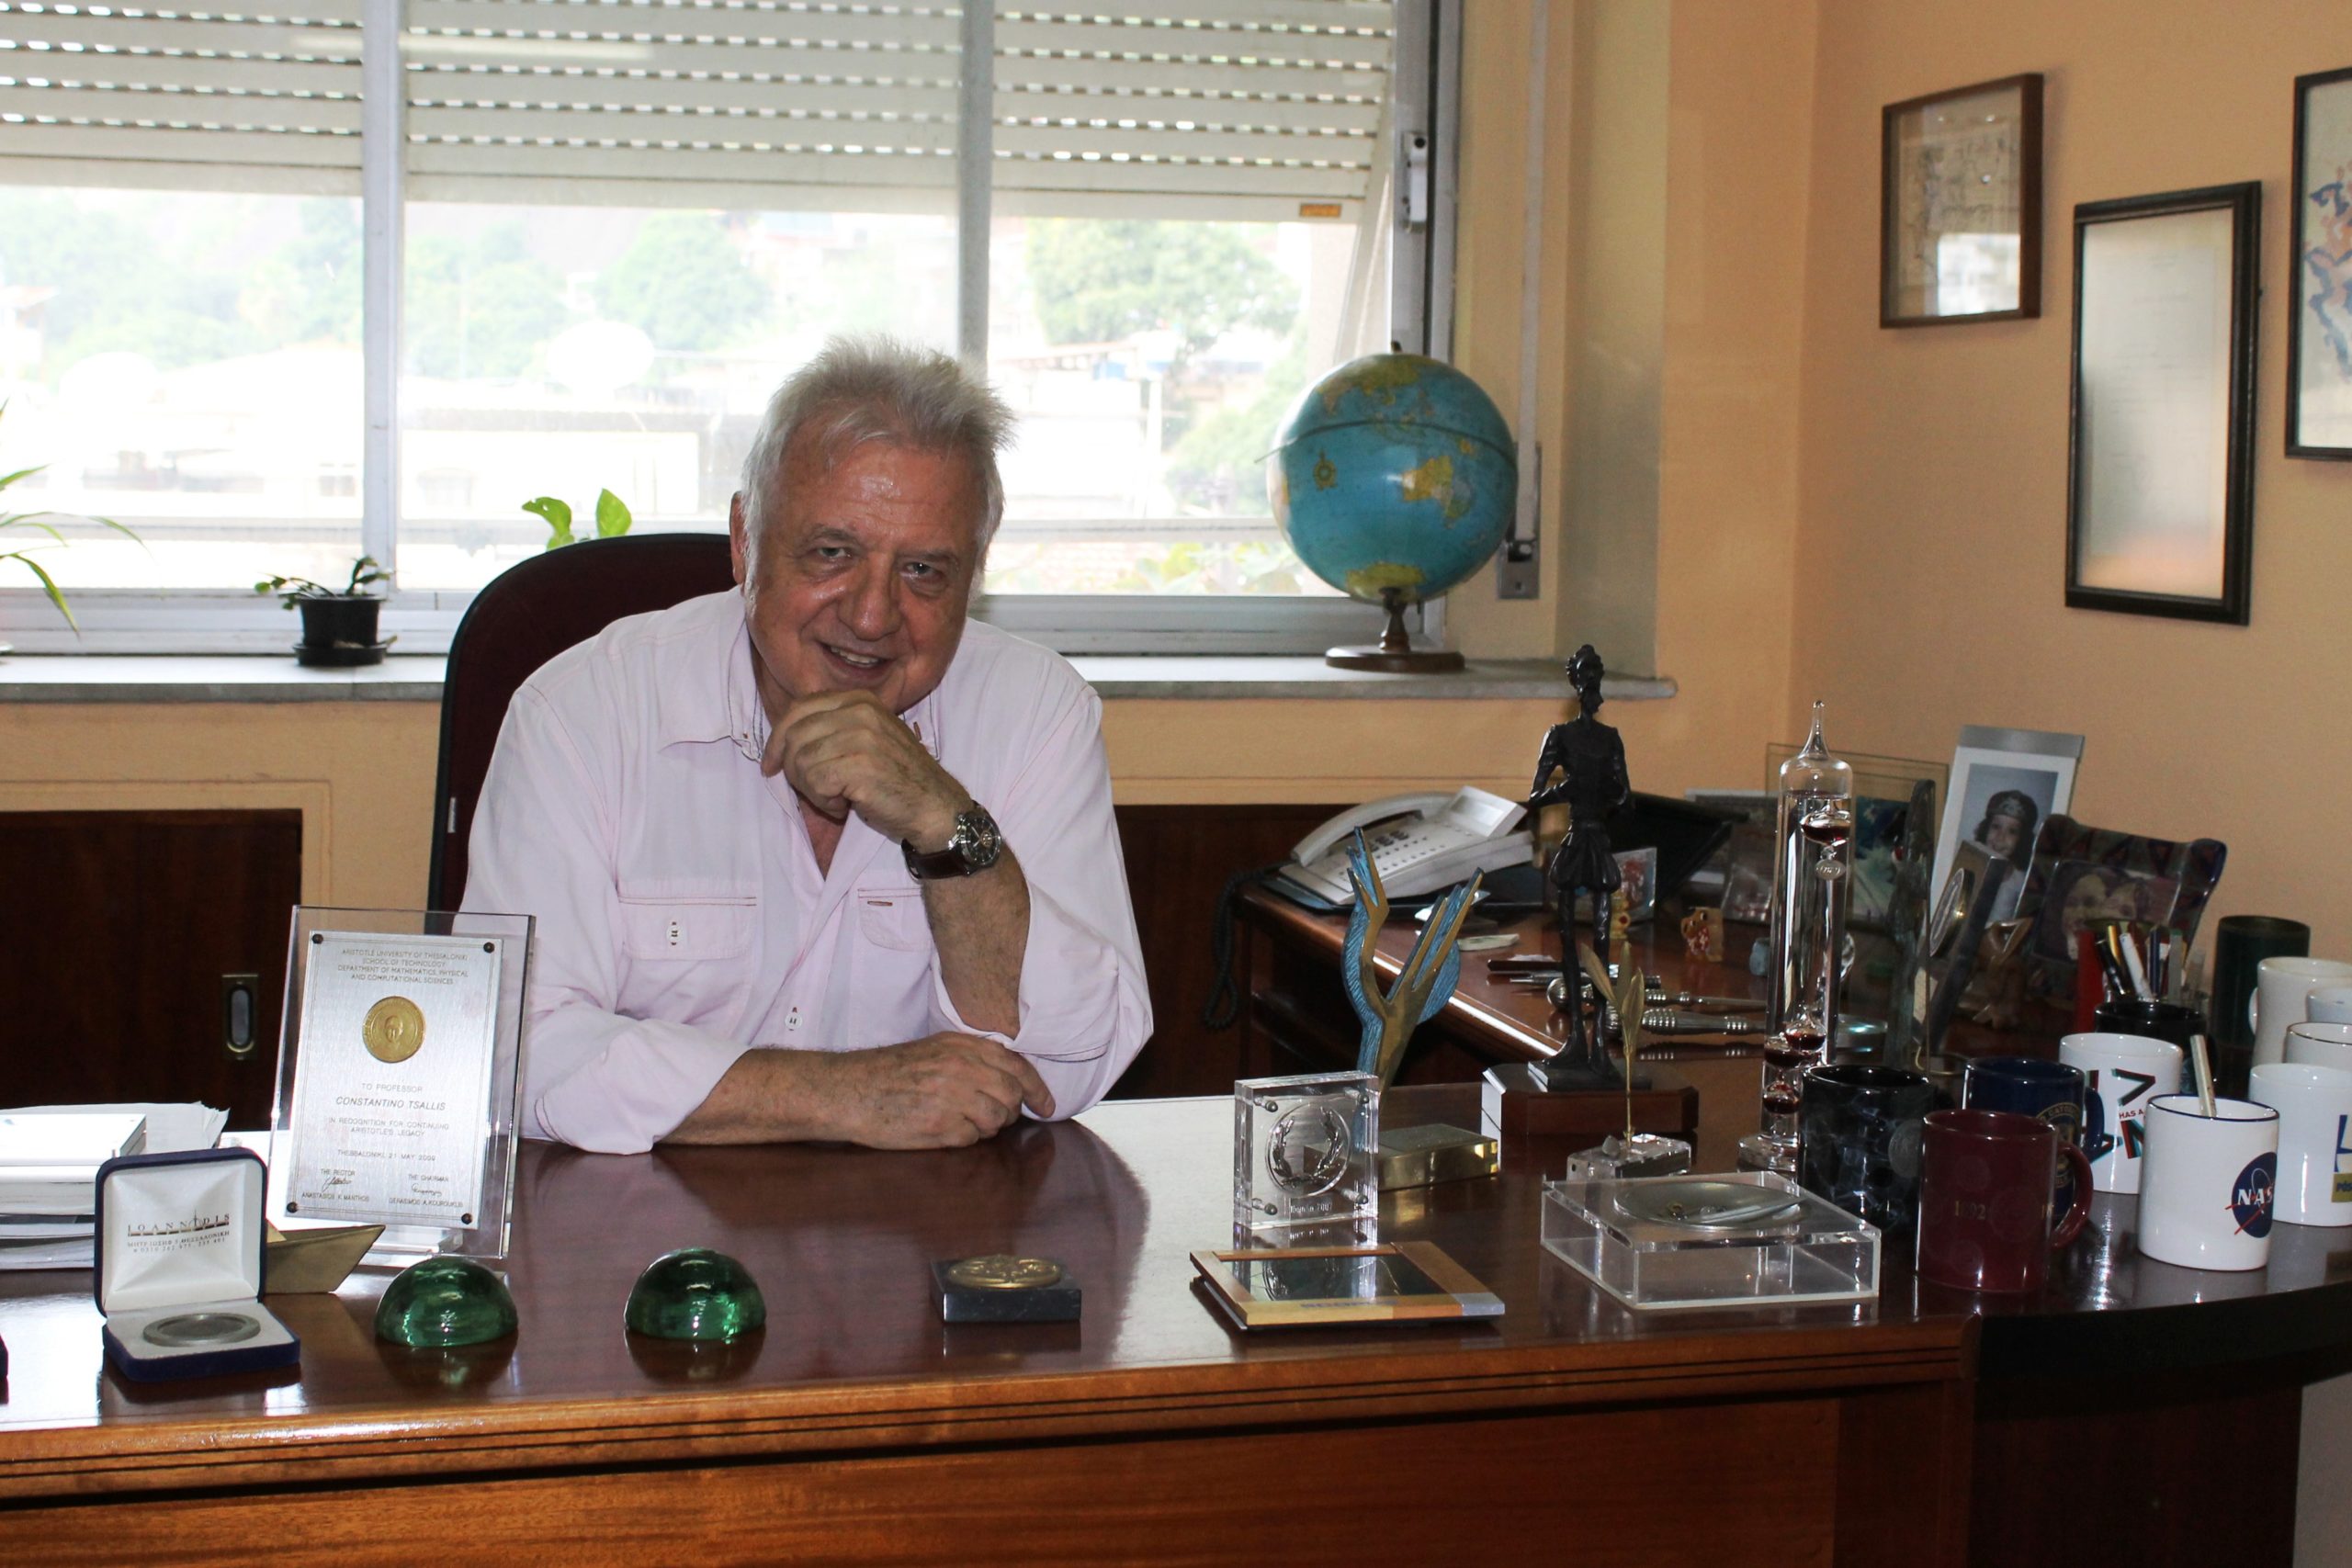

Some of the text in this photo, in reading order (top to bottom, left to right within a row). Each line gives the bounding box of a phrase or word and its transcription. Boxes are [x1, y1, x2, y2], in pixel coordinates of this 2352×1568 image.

[376, 950, 413, 958] UNIVERSITY
[363, 957, 389, 965] SCHOOL
[401, 959, 446, 967] TECHNOLOGY
[337, 964, 379, 973] DEPARTMENT
[439, 969, 469, 977] PHYSICAL
[368, 975, 422, 983] COMPUTATIONAL
[424, 976, 454, 985] SCIENCES
[376, 1084, 424, 1093] PROFESSOR
[335, 1096, 447, 1111] CONSTANTINO TSALLIS
[2119, 1110, 2136, 1120] HAS
[338, 1117, 386, 1126] RECOGNITION
[406, 1122, 449, 1130] CONTINUING
[397, 1128, 425, 1137] LEGACY
[333, 1168, 356, 1177] RECTOR
[2237, 1187, 2273, 1205] NAS
[128, 1212, 230, 1236] IOANNIDIS
